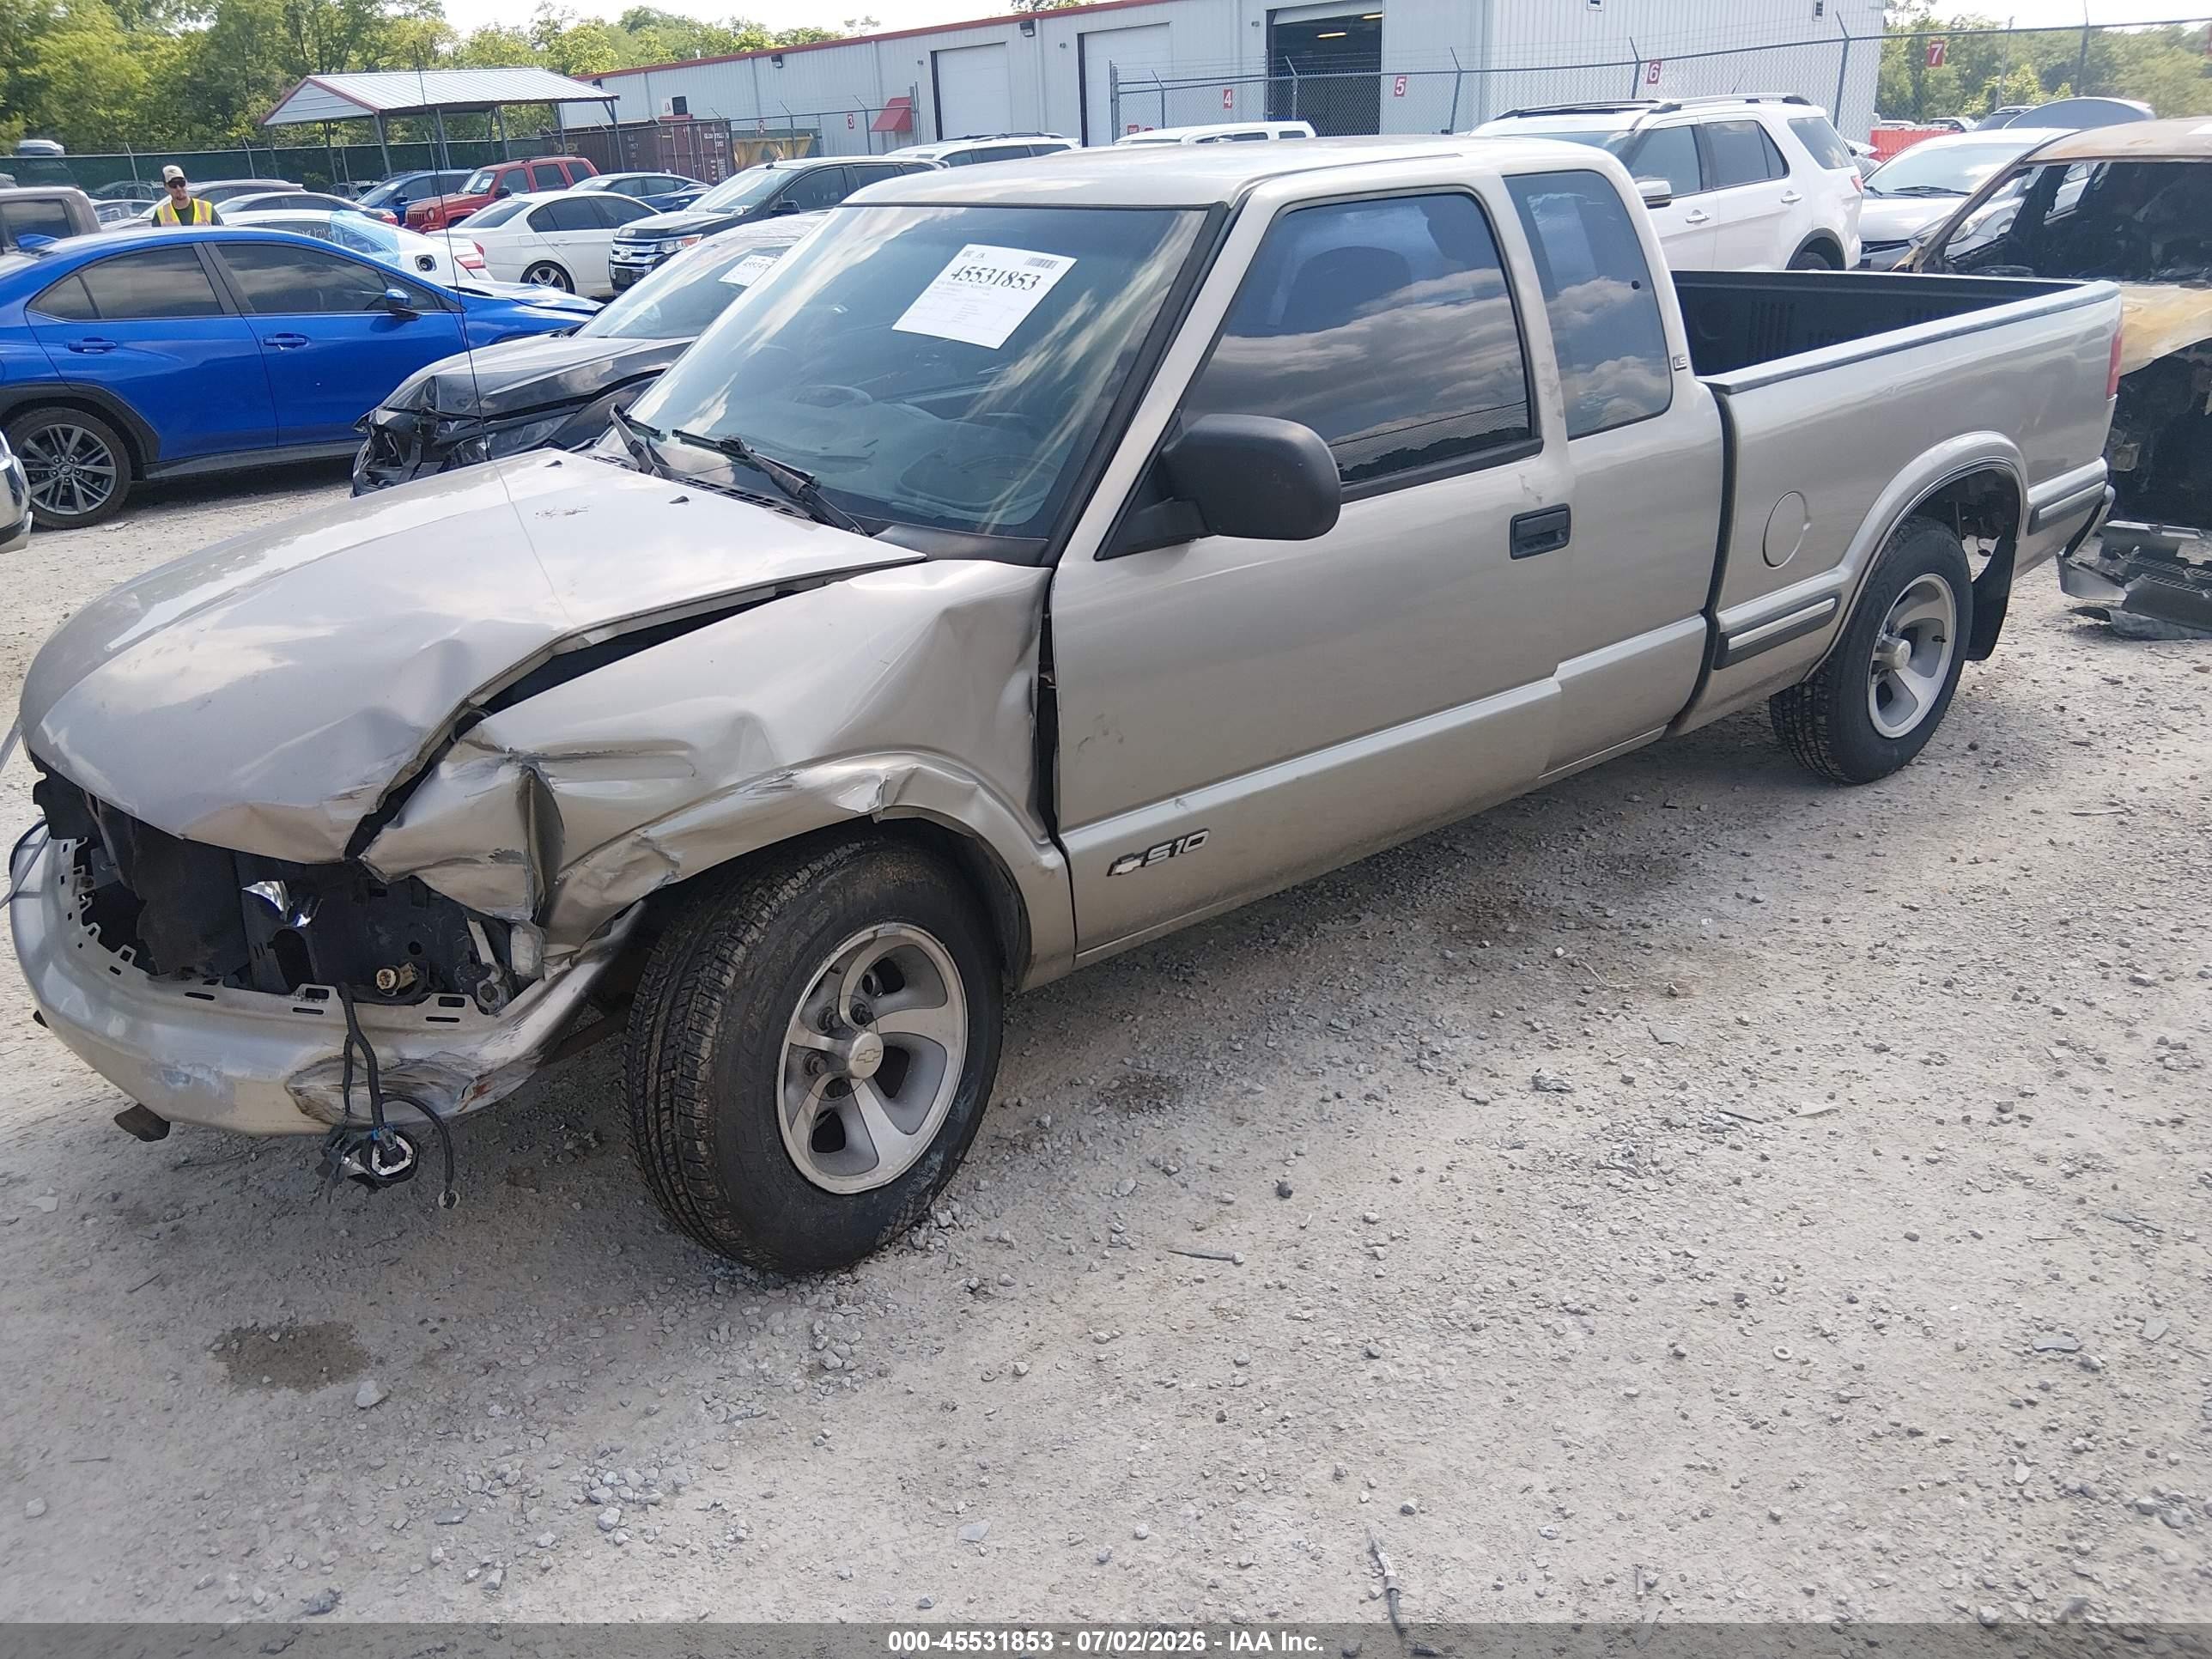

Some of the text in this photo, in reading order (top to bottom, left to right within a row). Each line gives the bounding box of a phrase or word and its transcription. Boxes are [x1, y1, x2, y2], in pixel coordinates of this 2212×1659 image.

[1930, 43, 1944, 64] 7
[1649, 64, 1660, 82] 6
[1395, 78, 1405, 94] 5
[1224, 91, 1232, 106] 4
[848, 116, 854, 128] 3
[950, 264, 1042, 292] 45531853
[1145, 828, 1210, 867] S10
